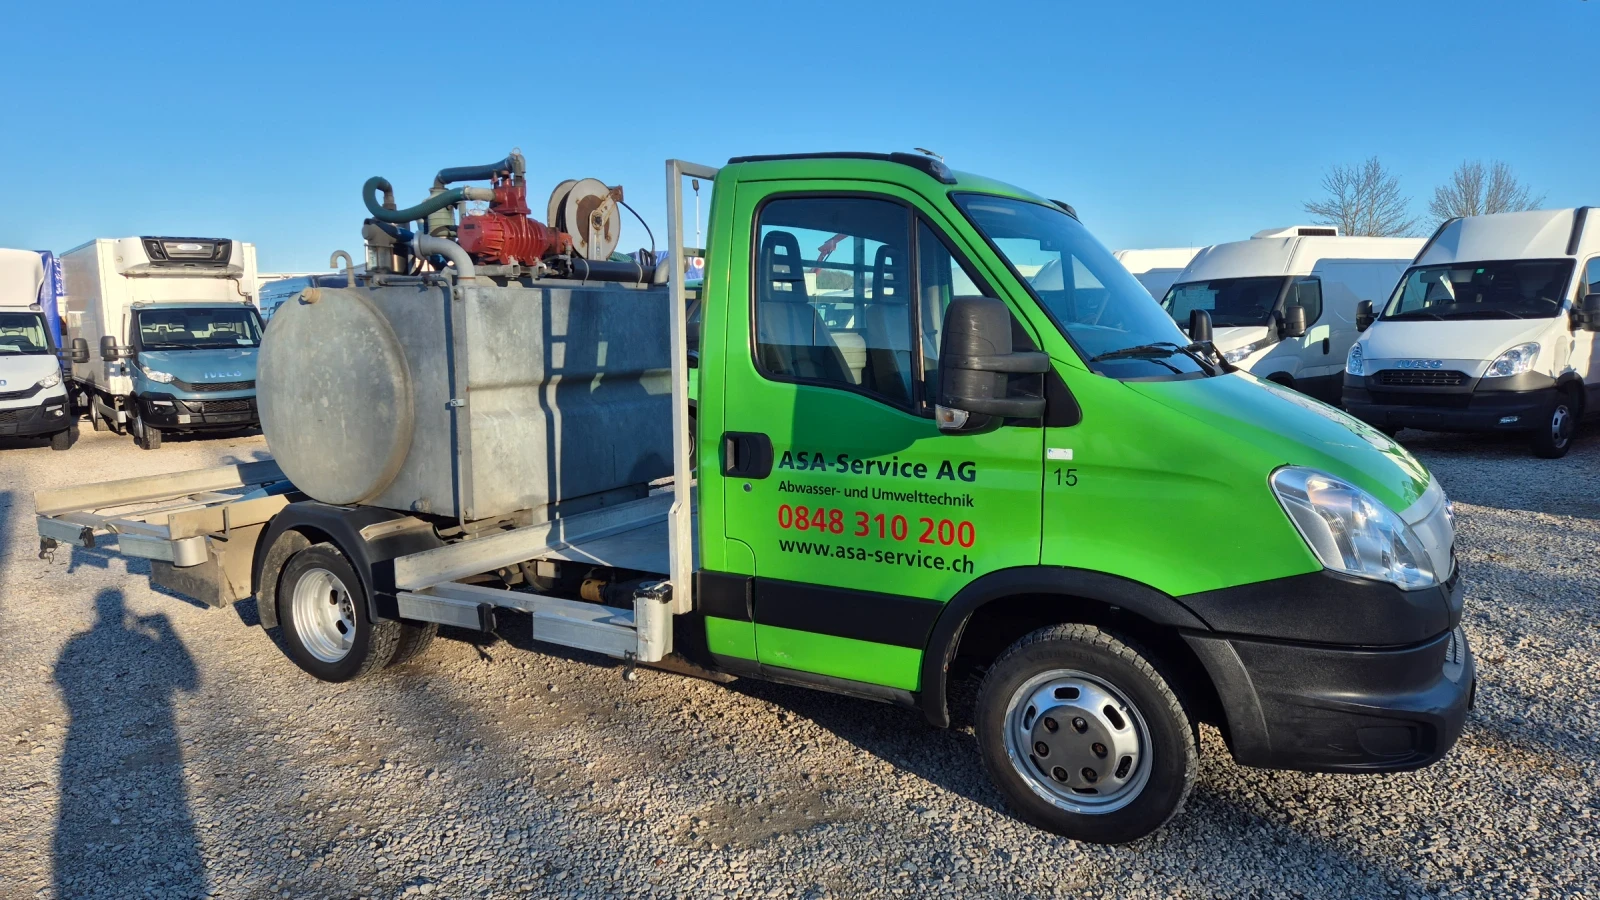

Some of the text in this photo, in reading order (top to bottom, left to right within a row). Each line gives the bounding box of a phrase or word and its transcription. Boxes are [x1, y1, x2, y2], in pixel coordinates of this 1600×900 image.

[204, 371, 242, 379] IVECO
[1396, 359, 1443, 369] IVECO
[778, 450, 977, 482] ASA-Service AG
[1053, 468, 1078, 487] 15
[778, 480, 974, 507] Abwasser- und Umwelttechnik
[778, 504, 976, 548] 0848 310 200
[779, 539, 974, 574] www.asa-service.ch
